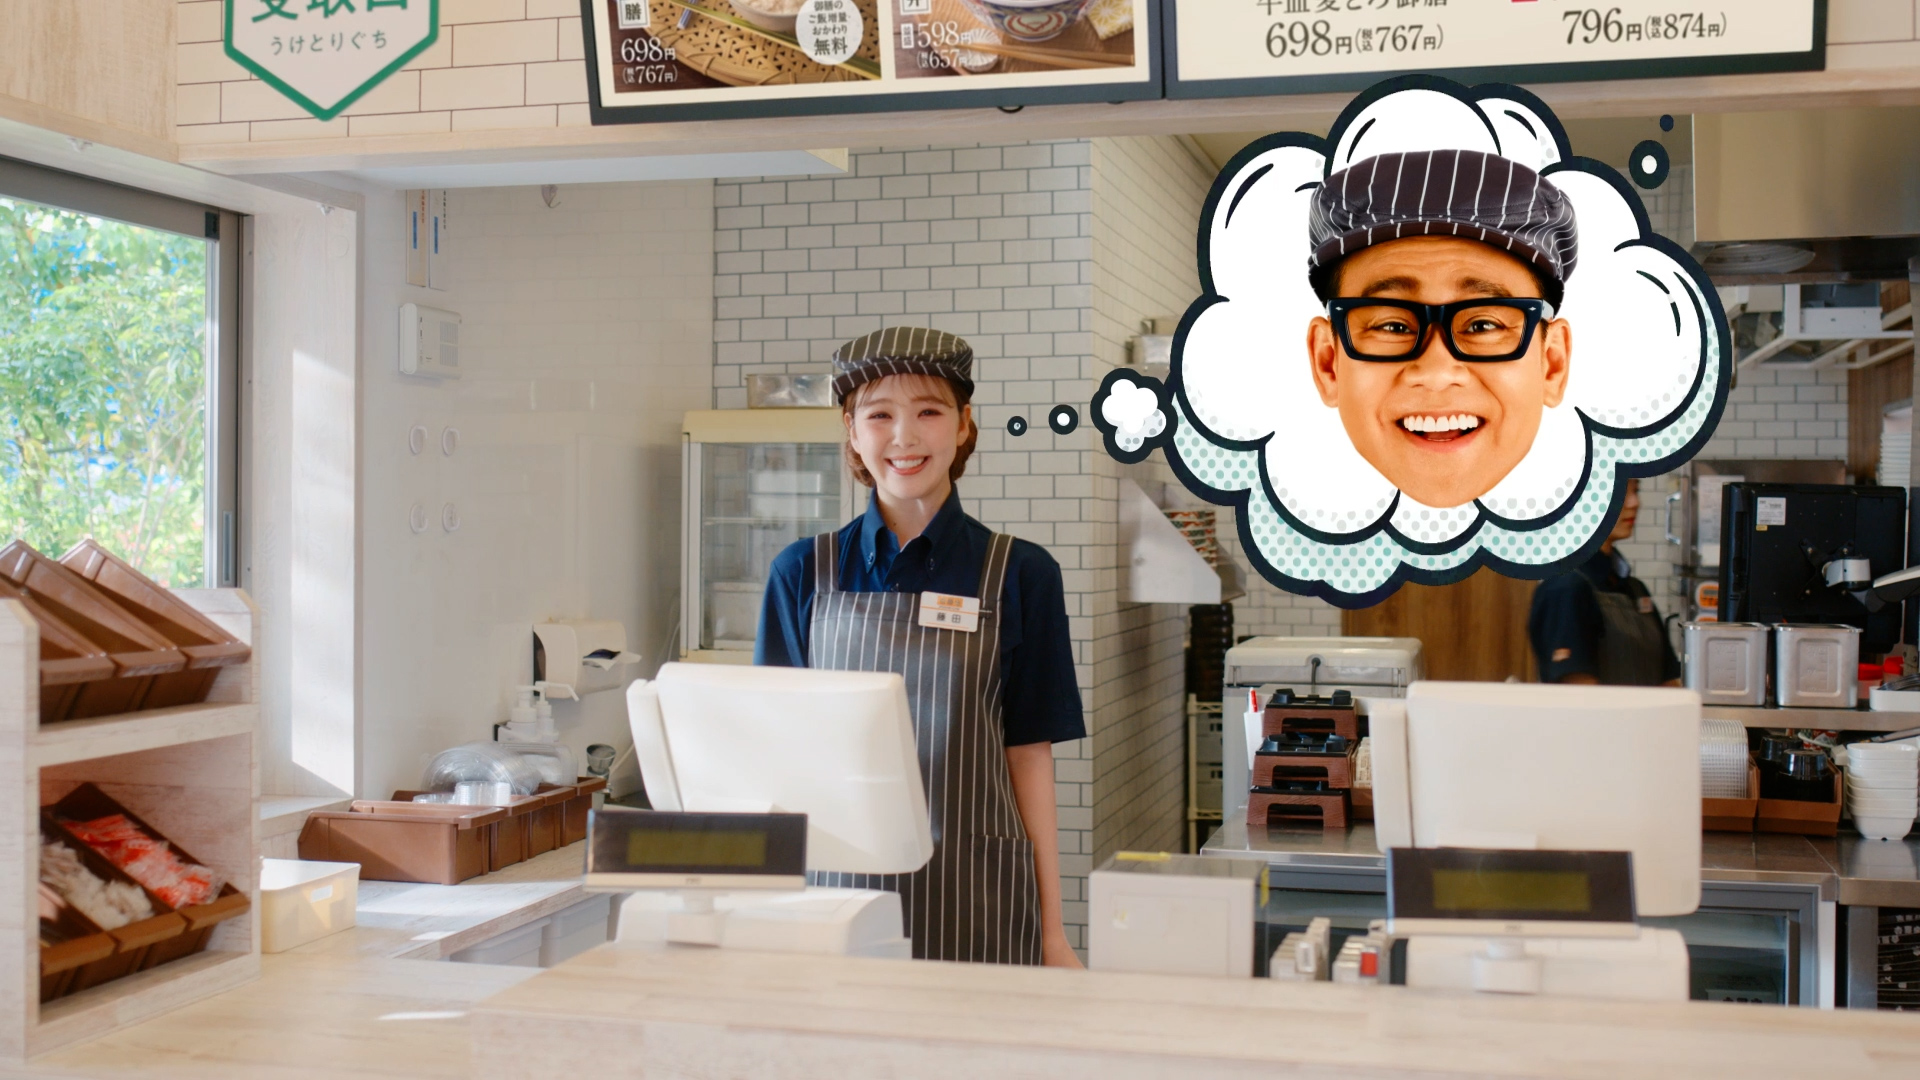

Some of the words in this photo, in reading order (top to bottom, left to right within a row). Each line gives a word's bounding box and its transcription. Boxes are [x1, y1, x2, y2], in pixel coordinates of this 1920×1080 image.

[812, 24, 848, 35] おかわり
[271, 29, 387, 55] うけとりぐち
[621, 37, 676, 63] 698円
[814, 36, 848, 56] 無料
